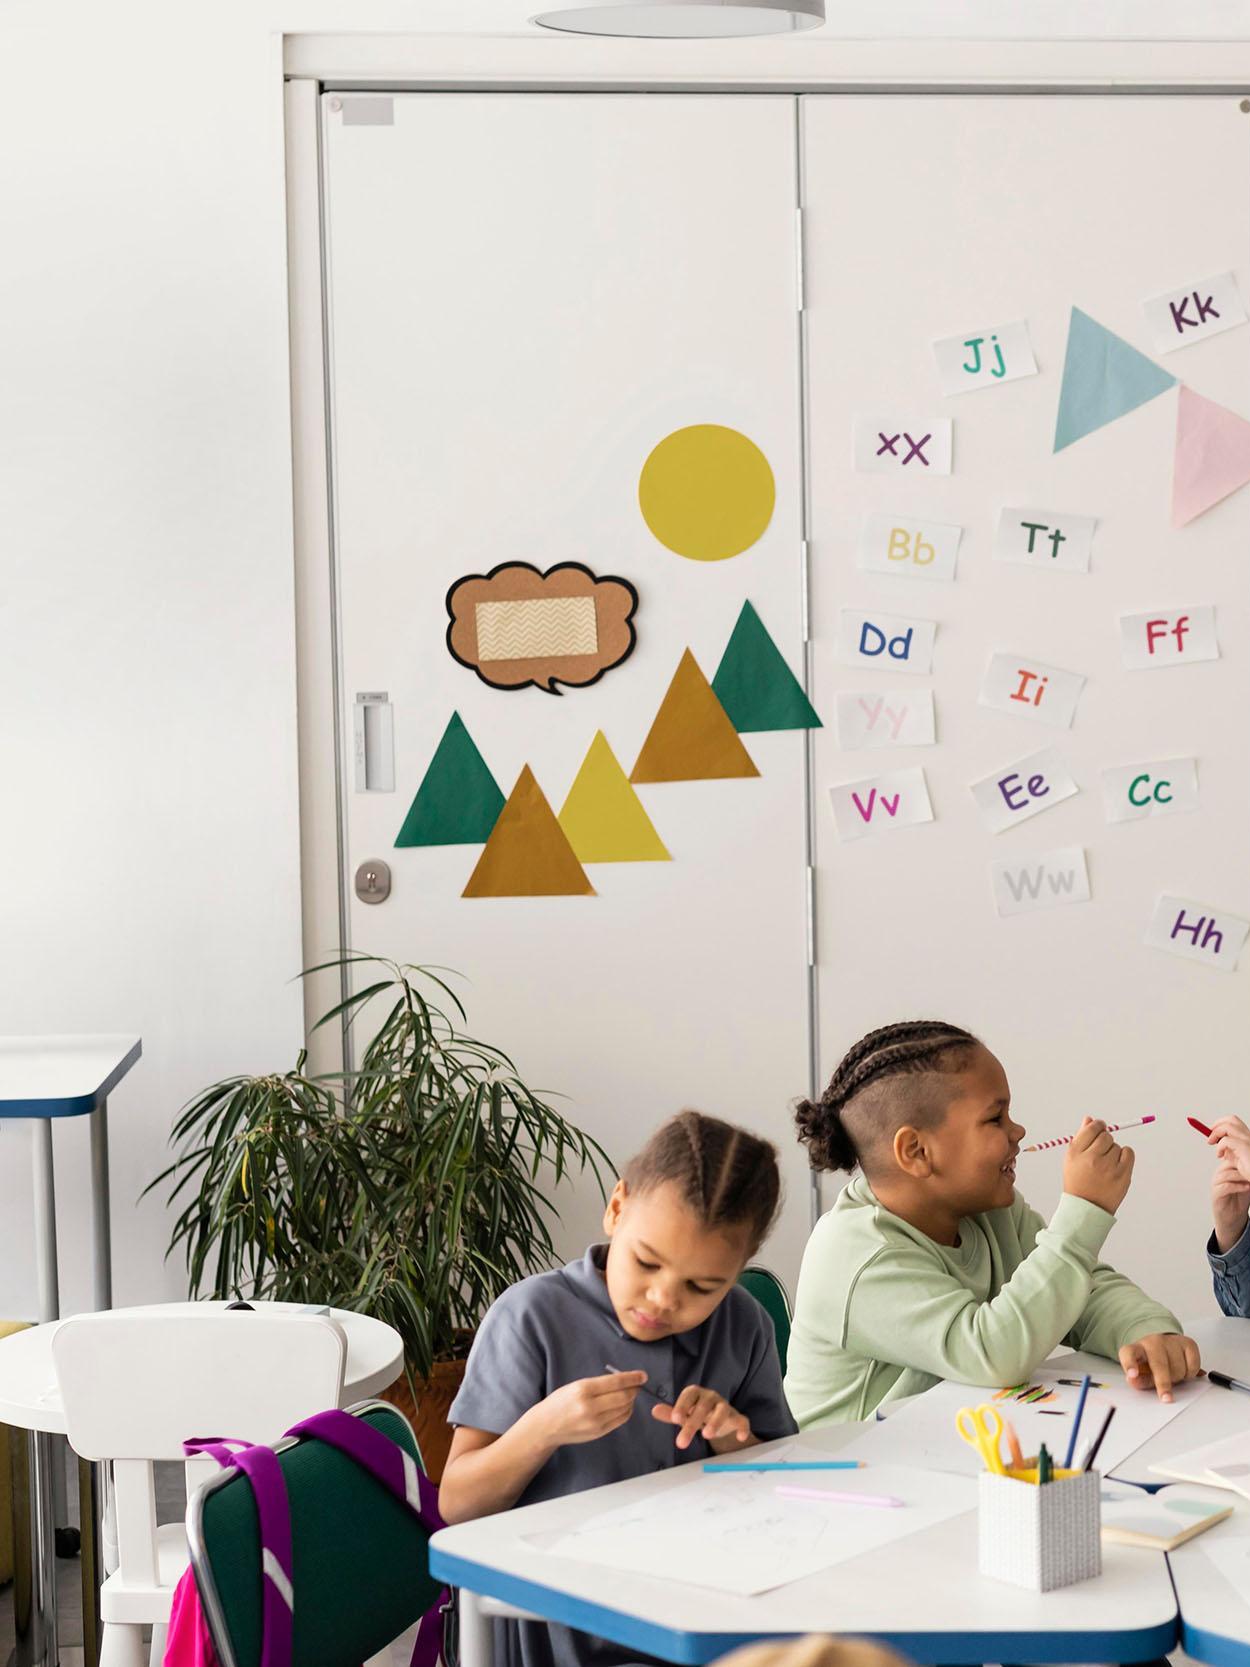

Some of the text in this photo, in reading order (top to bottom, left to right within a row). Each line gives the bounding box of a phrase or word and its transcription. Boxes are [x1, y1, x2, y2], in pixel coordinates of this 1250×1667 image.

[1169, 292, 1220, 333] Kk
[963, 335, 1006, 378] Jj
[888, 528, 935, 565] Bb
[1021, 522, 1066, 558] Tt
[859, 622, 913, 660] Dd
[1147, 616, 1189, 654] Ff
[1010, 670, 1048, 706] Ii
[857, 696, 910, 740] Yy
[852, 788, 899, 822] Vv
[998, 774, 1049, 810] Ee
[1128, 774, 1172, 806] Cc
[1003, 865, 1076, 902] Ww
[1171, 910, 1223, 953] Hh
